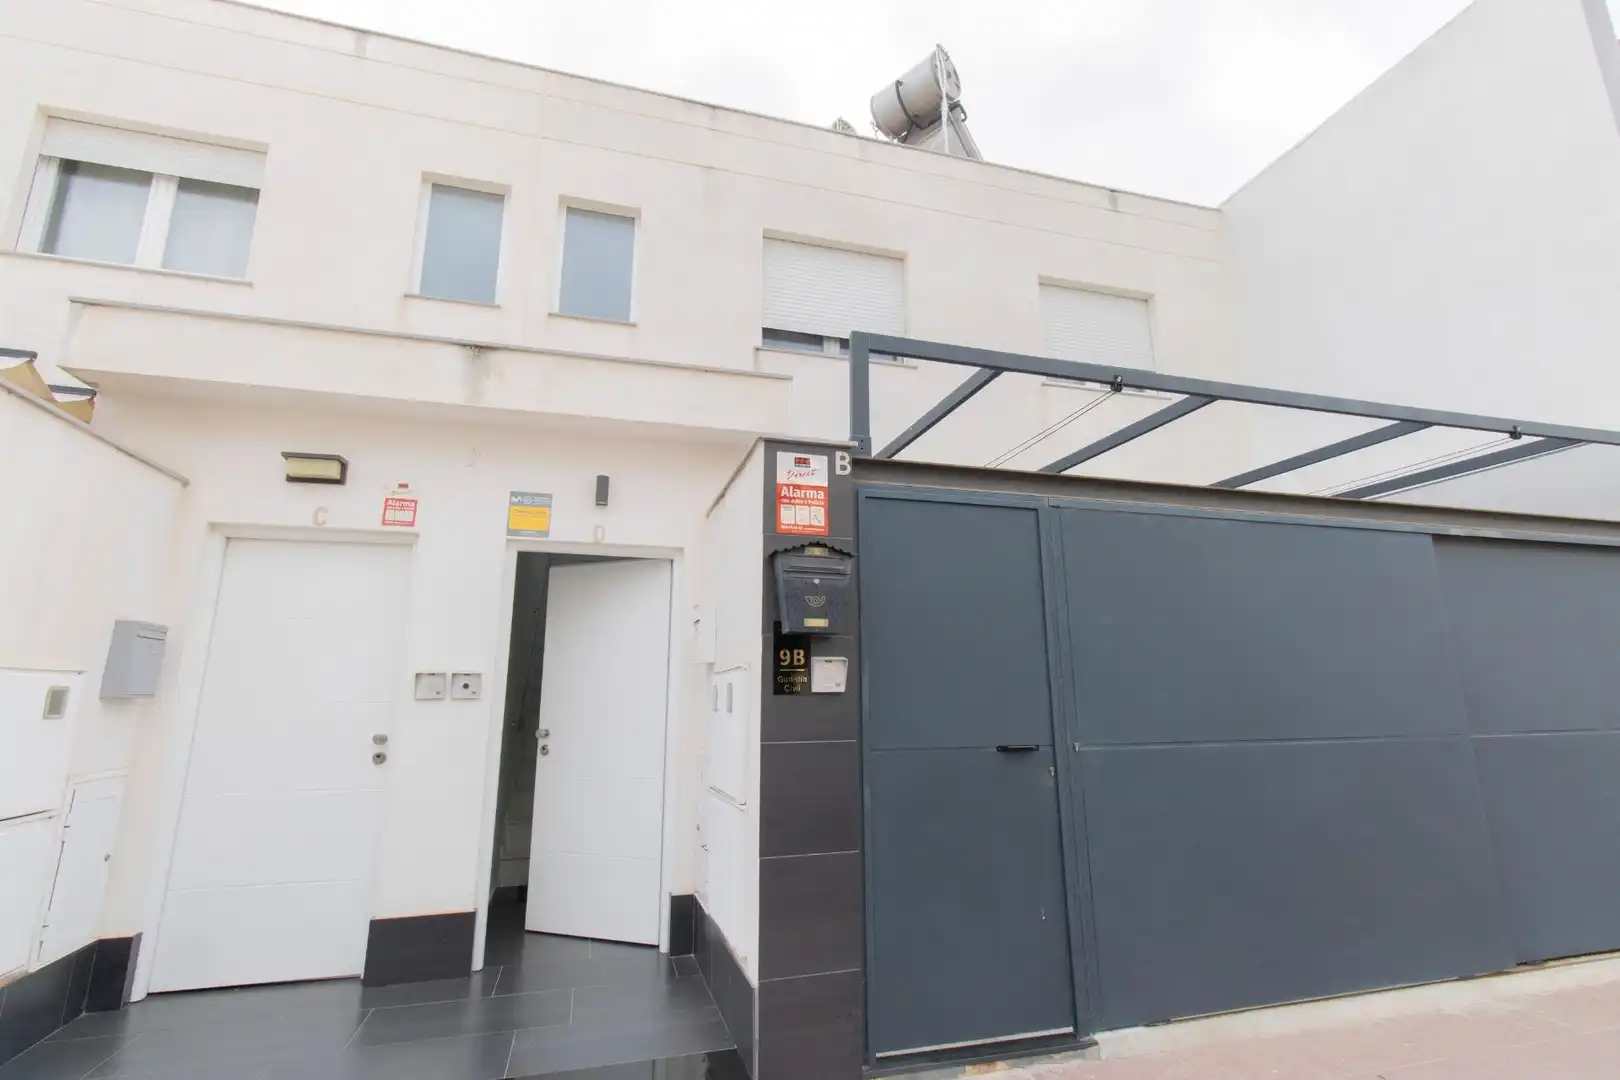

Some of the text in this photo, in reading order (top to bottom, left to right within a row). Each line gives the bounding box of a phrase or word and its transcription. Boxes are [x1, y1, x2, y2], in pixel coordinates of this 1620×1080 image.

[835, 451, 851, 475] B
[781, 486, 824, 499] Alarma
[387, 499, 415, 507] Alarma
[313, 506, 328, 526] C
[779, 649, 805, 665] 9B
[784, 684, 801, 692] Civil
